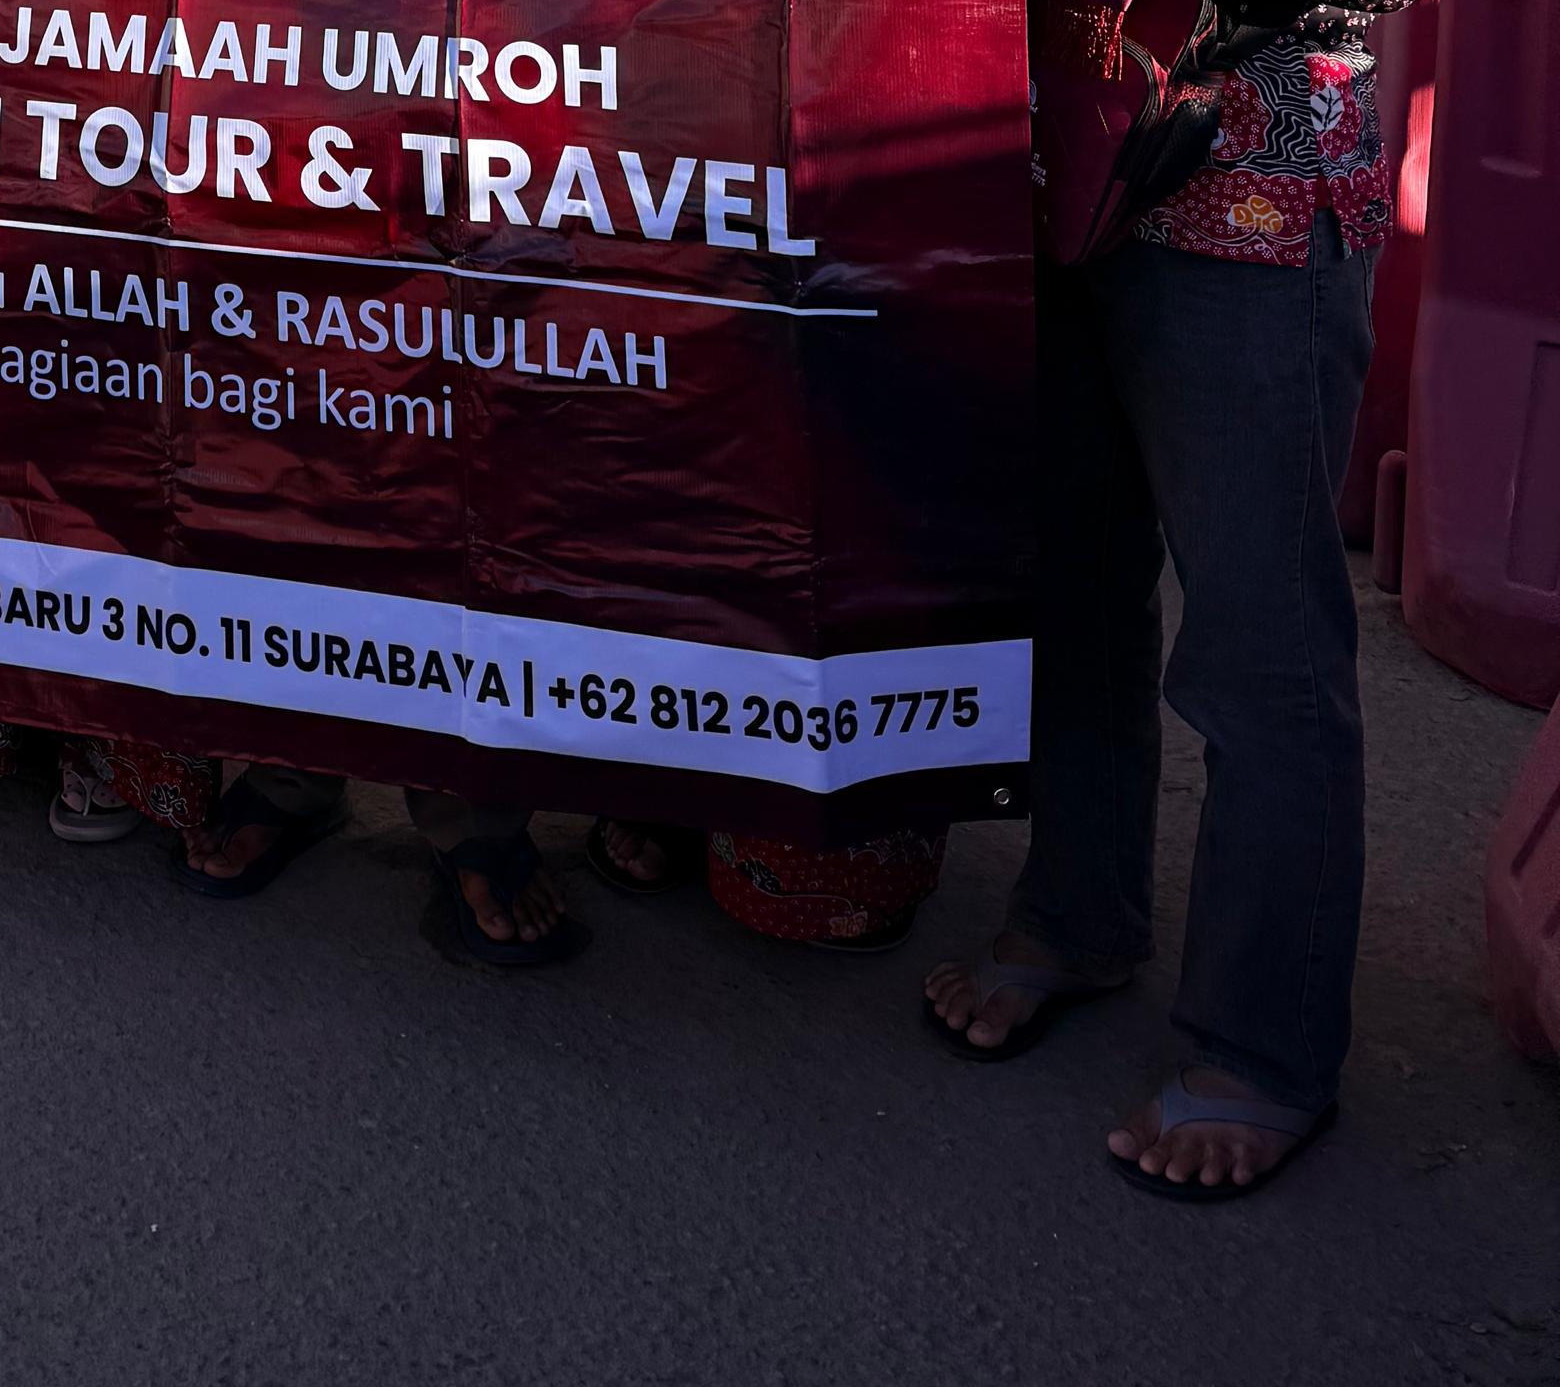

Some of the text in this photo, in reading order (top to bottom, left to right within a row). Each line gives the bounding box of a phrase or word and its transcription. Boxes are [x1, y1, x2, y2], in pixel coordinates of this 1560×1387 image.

[322, 29, 618, 111] UMROH
[26, 100, 273, 203] TOUR
[300, 125, 380, 211] &
[402, 132, 816, 257] TRAVEL
[24, 264, 189, 332] ALLAH
[211, 282, 257, 340] &
[183, 353, 296, 430] bagi
[319, 369, 453, 439] kami
[102, 598, 125, 641] 3
[137, 605, 210, 657] NO.
[220, 616, 251, 663] 11
[263, 625, 510, 708] SURABAYA
[549, 674, 637, 725] +62
[651, 686, 731, 735] 812
[743, 695, 857, 752] 2036
[871, 687, 980, 738] 7775
